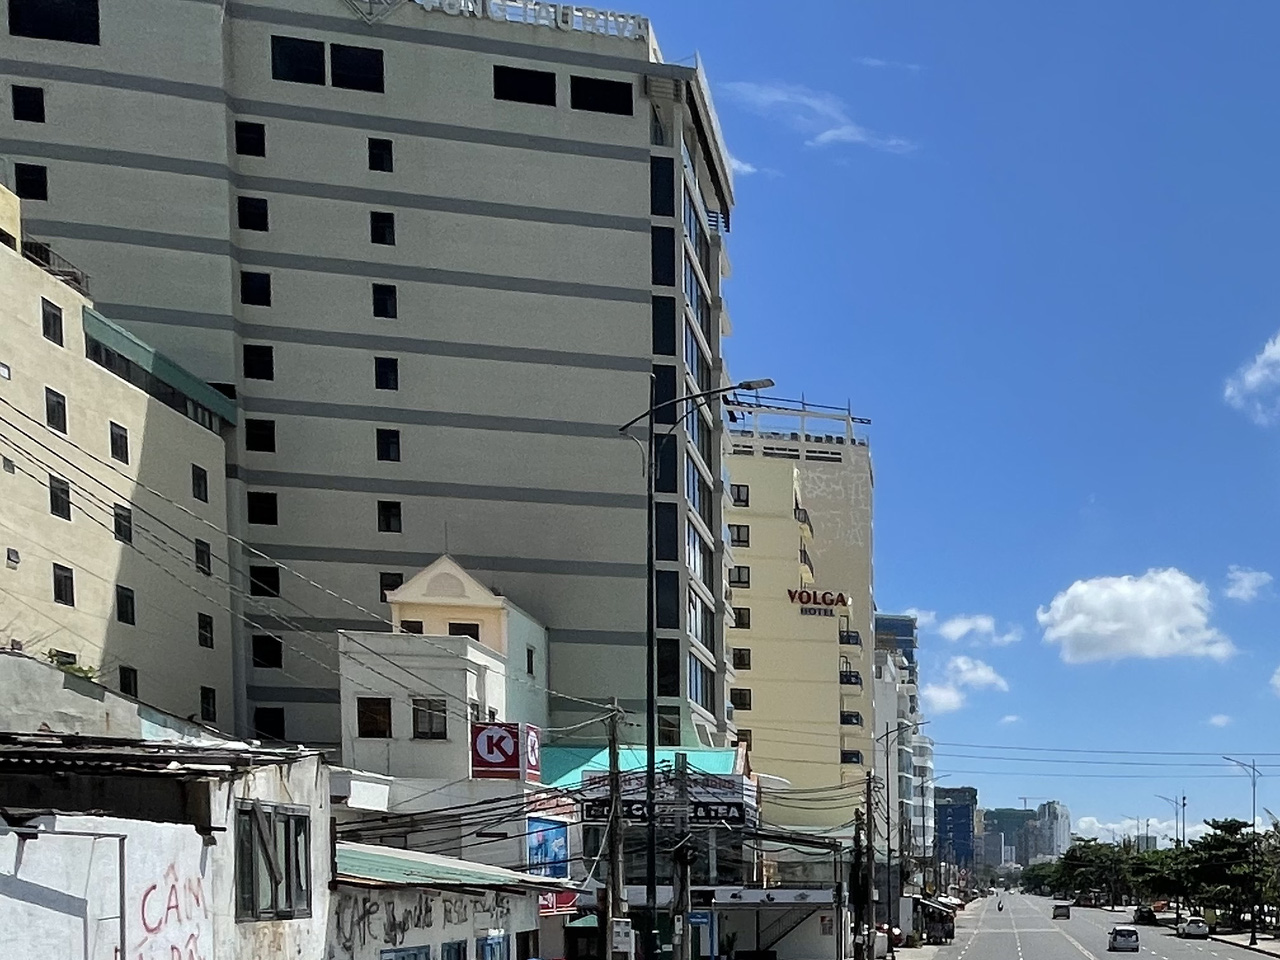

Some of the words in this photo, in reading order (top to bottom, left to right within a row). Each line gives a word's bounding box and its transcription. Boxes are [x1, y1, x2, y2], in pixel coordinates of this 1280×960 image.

[787, 589, 847, 606] VOLGA
[800, 607, 835, 617] HOTEL
[708, 805, 740, 818] TEA
